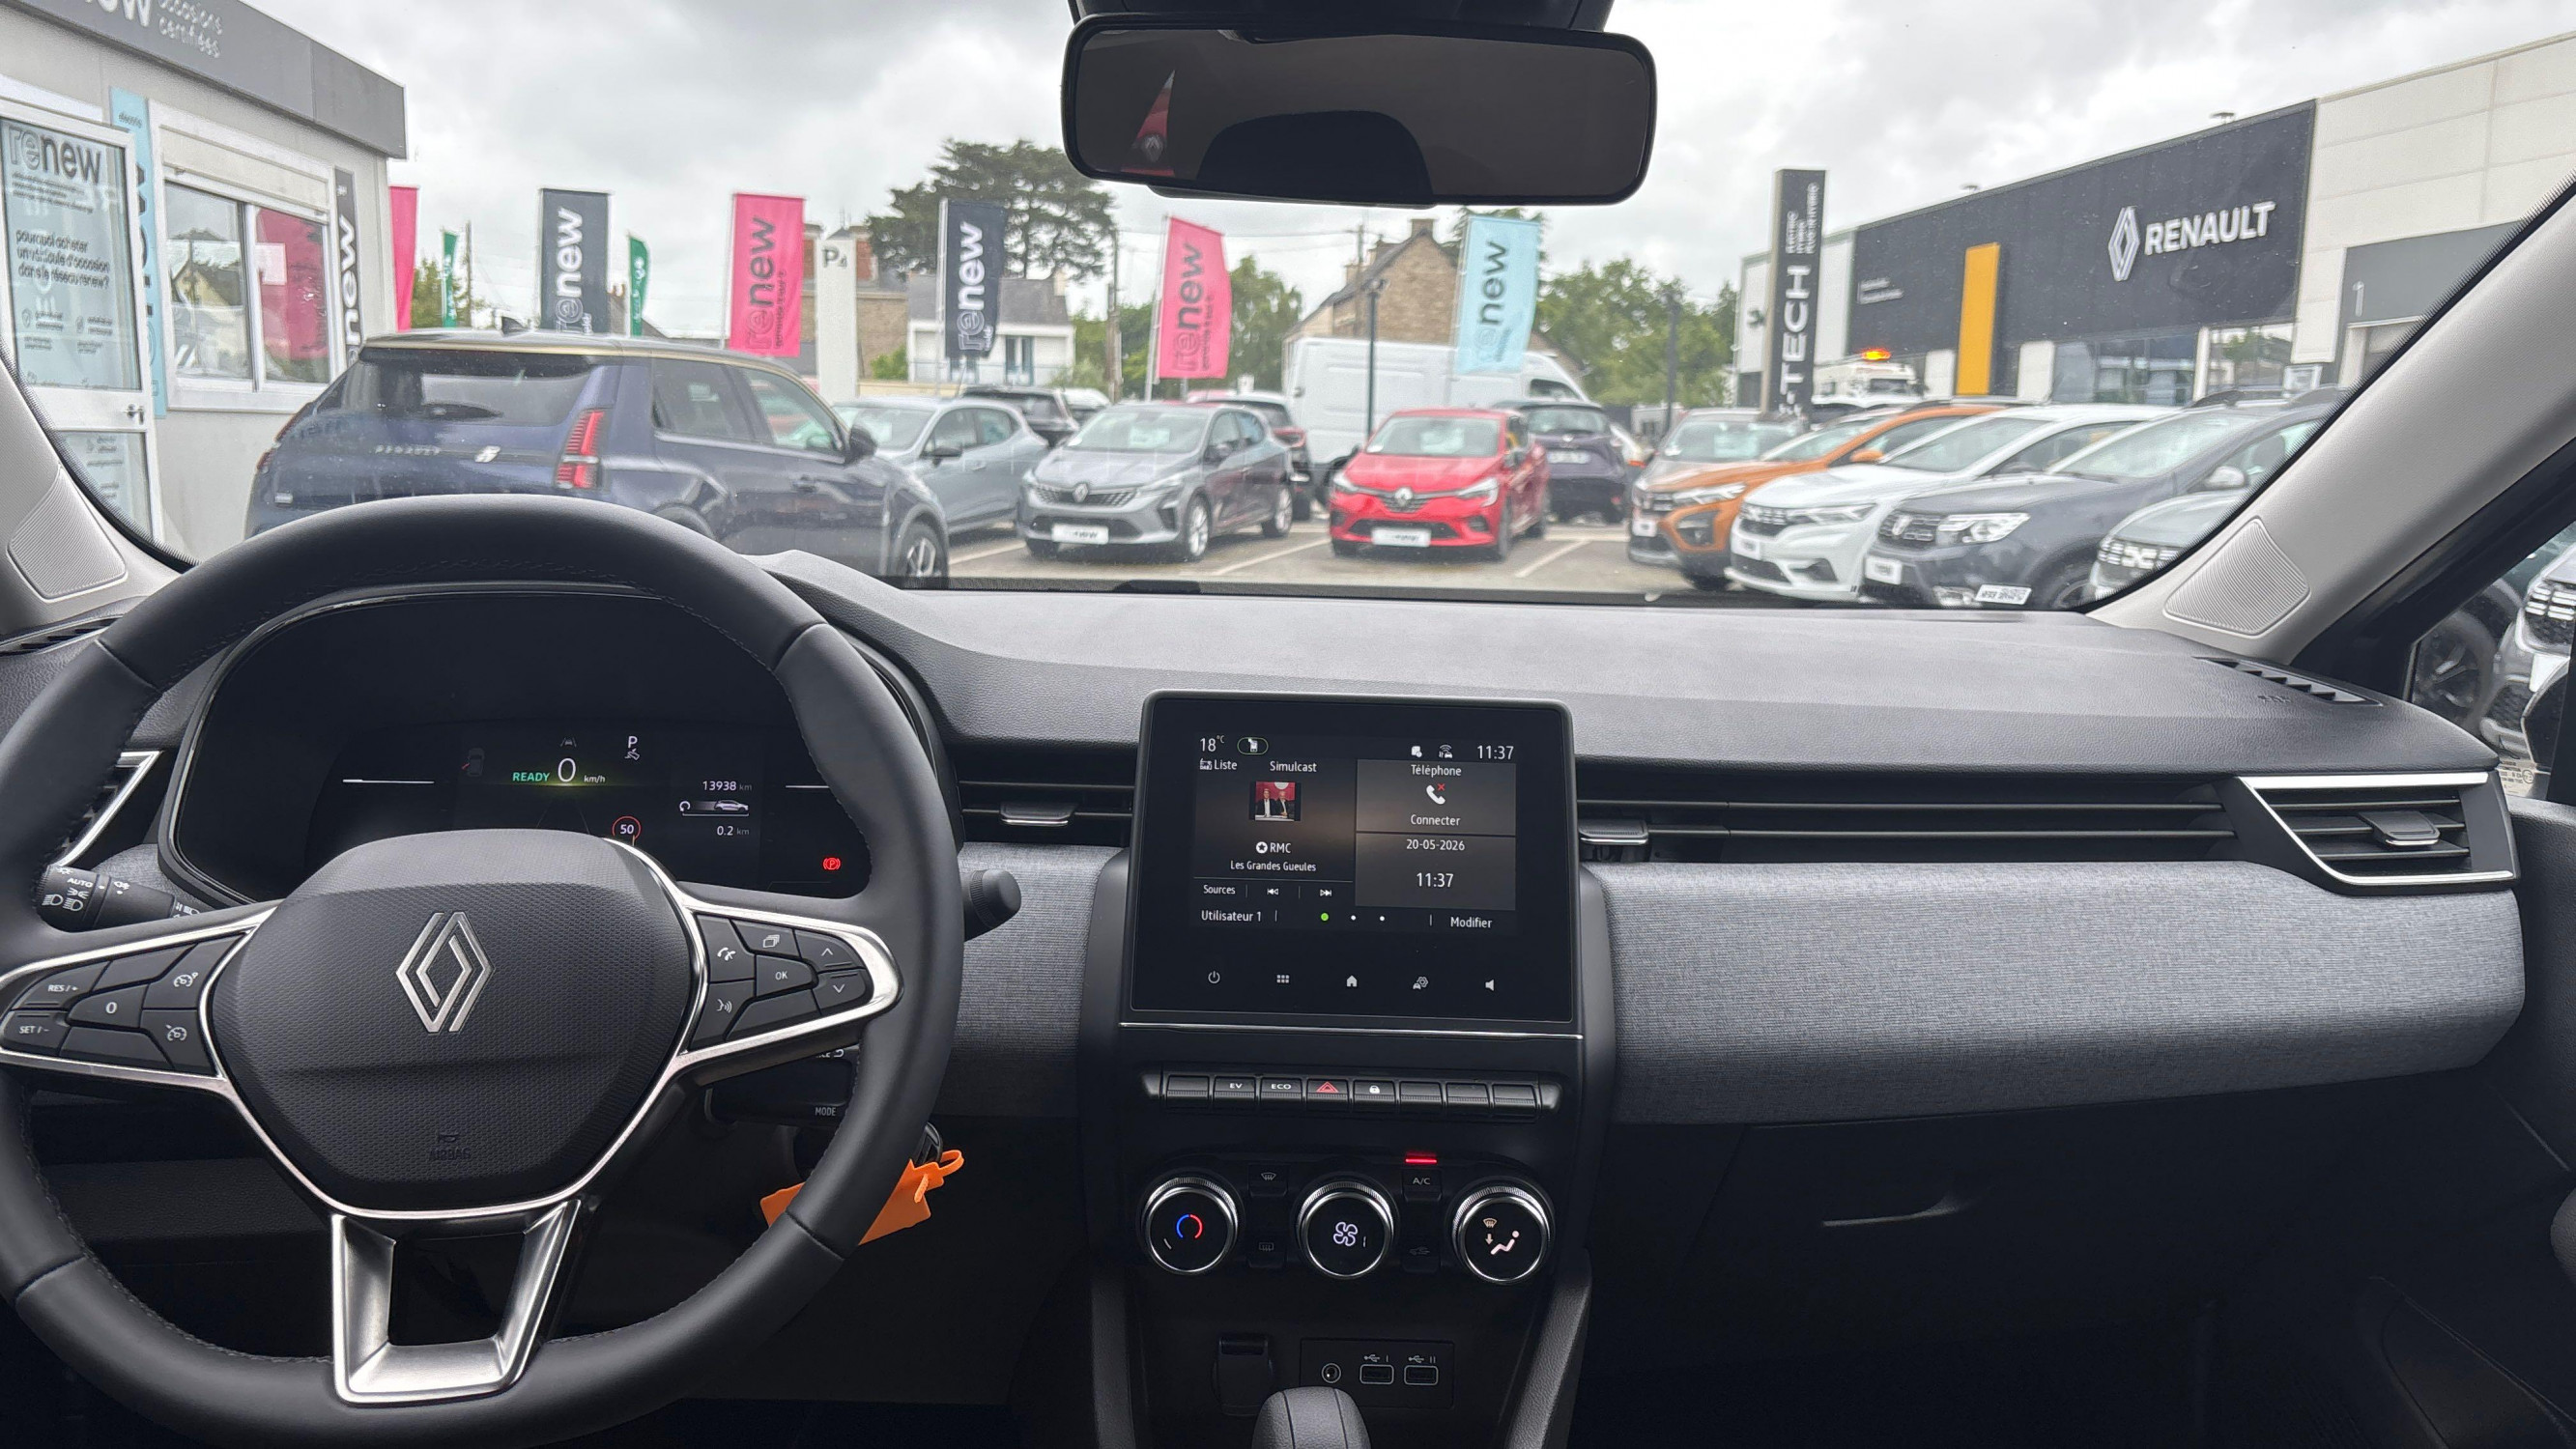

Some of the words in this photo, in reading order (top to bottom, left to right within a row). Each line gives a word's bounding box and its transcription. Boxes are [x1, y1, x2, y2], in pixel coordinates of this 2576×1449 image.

[9, 127, 101, 184] renew
[2144, 200, 2276, 255] RENAULT
[557, 206, 584, 333] renew
[745, 214, 776, 349] renew
[957, 220, 985, 350] renew
[1164, 242, 1203, 371] renew
[628, 736, 638, 749] P
[1477, 745, 1514, 759] 11:37
[512, 772, 550, 781] READY
[558, 757, 577, 782] 0
[584, 775, 606, 783] km/h
[1215, 759, 1237, 770] Liste
[1270, 761, 1317, 772] Simulcast
[1411, 764, 1462, 778] Téléphone
[702, 781, 737, 791] 13938
[1411, 814, 1461, 826] Connecter
[619, 824, 635, 835] 50
[717, 826, 733, 836] 0.2
[1270, 842, 1291, 853] RMC
[1407, 839, 1465, 850] 20-05-2026
[1230, 860, 1245, 869] Les
[1246, 860, 1280, 871] Grandes
[1283, 862, 1317, 871] Gueules
[68, 877, 94, 888] AUTO
[1417, 872, 1453, 887] 11:37
[1203, 884, 1236, 895] Sources
[1201, 910, 1253, 922] Utilisateur
[1256, 911, 1262, 922] 1
[1450, 917, 1493, 928] Modifier
[775, 971, 788, 980] OK
[815, 1106, 837, 1117] MODE
[1413, 1177, 1430, 1185] A/C
